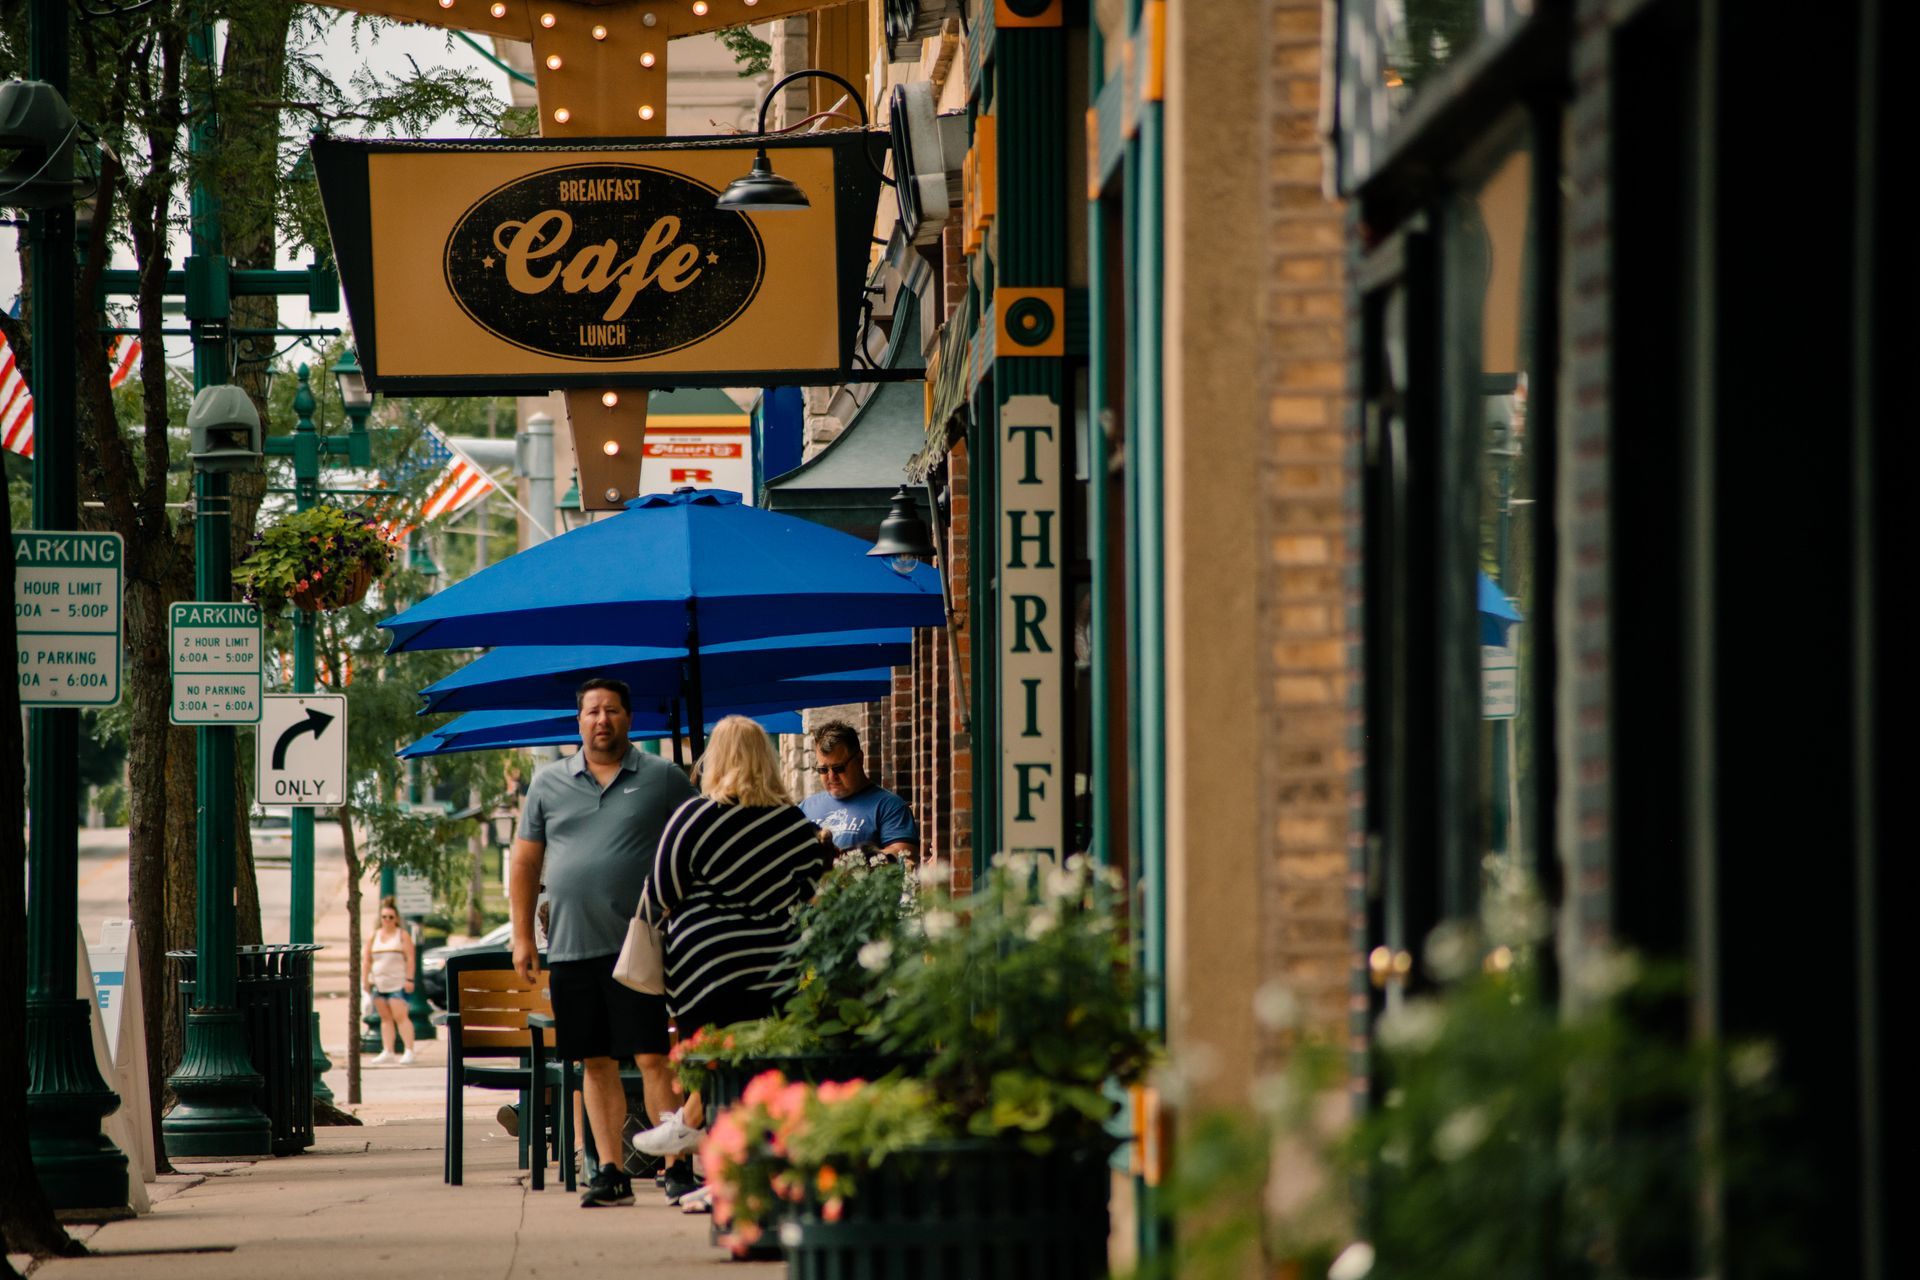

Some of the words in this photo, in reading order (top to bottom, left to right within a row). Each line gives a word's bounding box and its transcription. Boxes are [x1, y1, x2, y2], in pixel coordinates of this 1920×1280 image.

[559, 179, 641, 202] BREAKFAST
[493, 209, 702, 322] Cafe
[579, 325, 626, 346] LUNCH
[15, 538, 115, 562] ARKING
[24, 581, 60, 595] HOUR
[68, 582, 102, 596] LIMIT
[16, 603, 42, 617] 00A
[68, 604, 109, 618] 5:00P
[175, 607, 258, 624] PARKING
[184, 637, 190, 647] 2
[195, 637, 220, 647] HOUR
[225, 637, 250, 647] LIMIT
[17, 651, 29, 664] O
[37, 651, 96, 665] PARKING
[179, 653, 208, 663] 6:00A
[226, 653, 254, 663] 5:00P
[1006, 425, 1055, 906] THRIFT
[67, 673, 108, 687] 6:00A
[187, 686, 200, 695] NO
[205, 686, 246, 696] PARKING
[179, 701, 208, 711] 3:00A
[225, 701, 254, 711] 6:00A
[275, 779, 325, 796] ONLY
